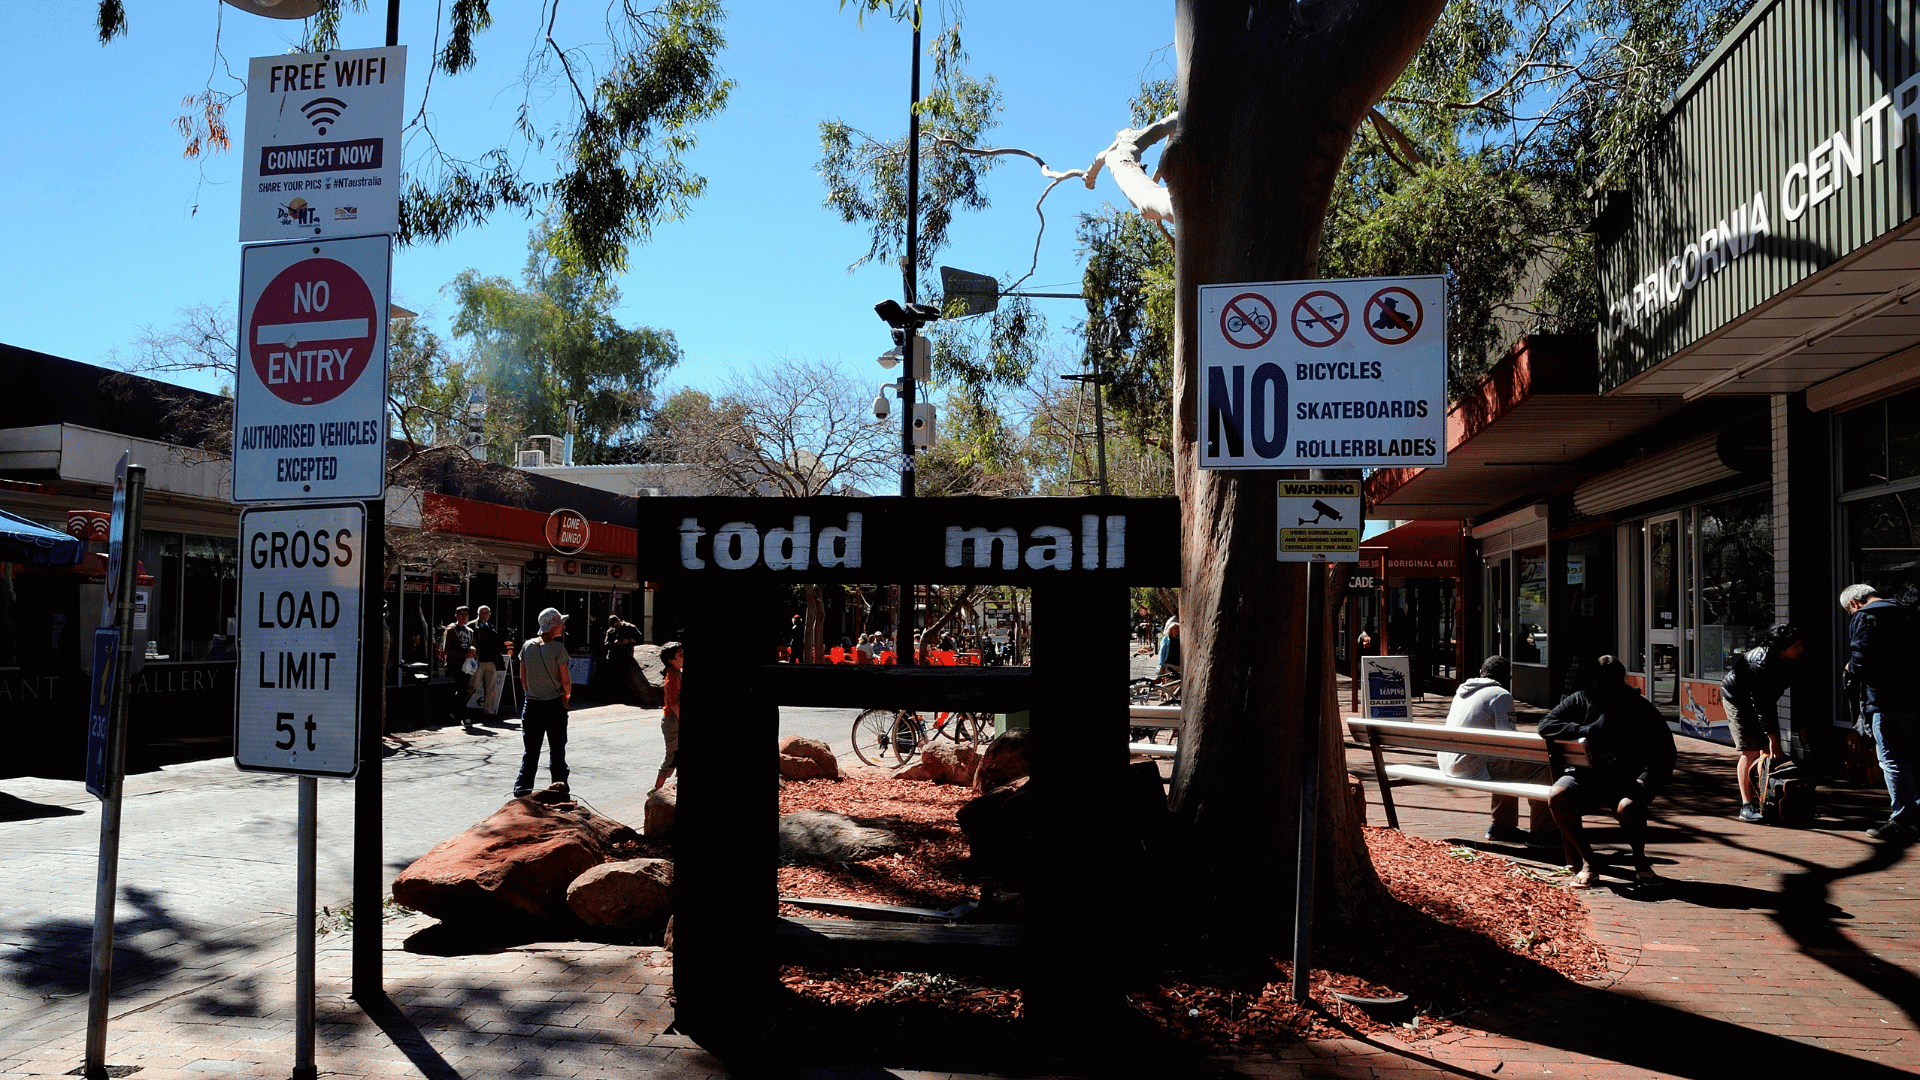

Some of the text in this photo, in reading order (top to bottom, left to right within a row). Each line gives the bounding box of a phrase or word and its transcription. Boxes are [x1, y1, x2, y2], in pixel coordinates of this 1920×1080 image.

[270, 57, 386, 93] FREE WIFI
[268, 145, 374, 170] CONNECT NOW
[259, 175, 382, 193] SHARE YOUR PICS #NTaustralia
[1608, 72, 1920, 342] CAPRICORNIA CENTR
[293, 280, 330, 314] NO
[268, 348, 353, 385] ENTRY
[1296, 361, 1382, 381] BICYCLES
[1208, 362, 1289, 459] NO
[1296, 400, 1428, 420] SKATEBOARDS
[241, 420, 377, 450] AUTHORISED VEHICLES
[1296, 438, 1436, 458] ROLLERBLADES
[277, 457, 337, 482] EXCEPTED
[1284, 484, 1354, 495] WARNING
[563, 517, 581, 530] LONE
[250, 528, 353, 569] GROSS
[561, 531, 582, 545] DINGO
[679, 512, 1126, 570] todd mall
[1348, 576, 1374, 588] CADE
[258, 591, 340, 629] LOAD
[128, 669, 219, 694] ALLERY
[259, 651, 336, 690] LIMIT
[1707, 687, 1723, 706] LEA
